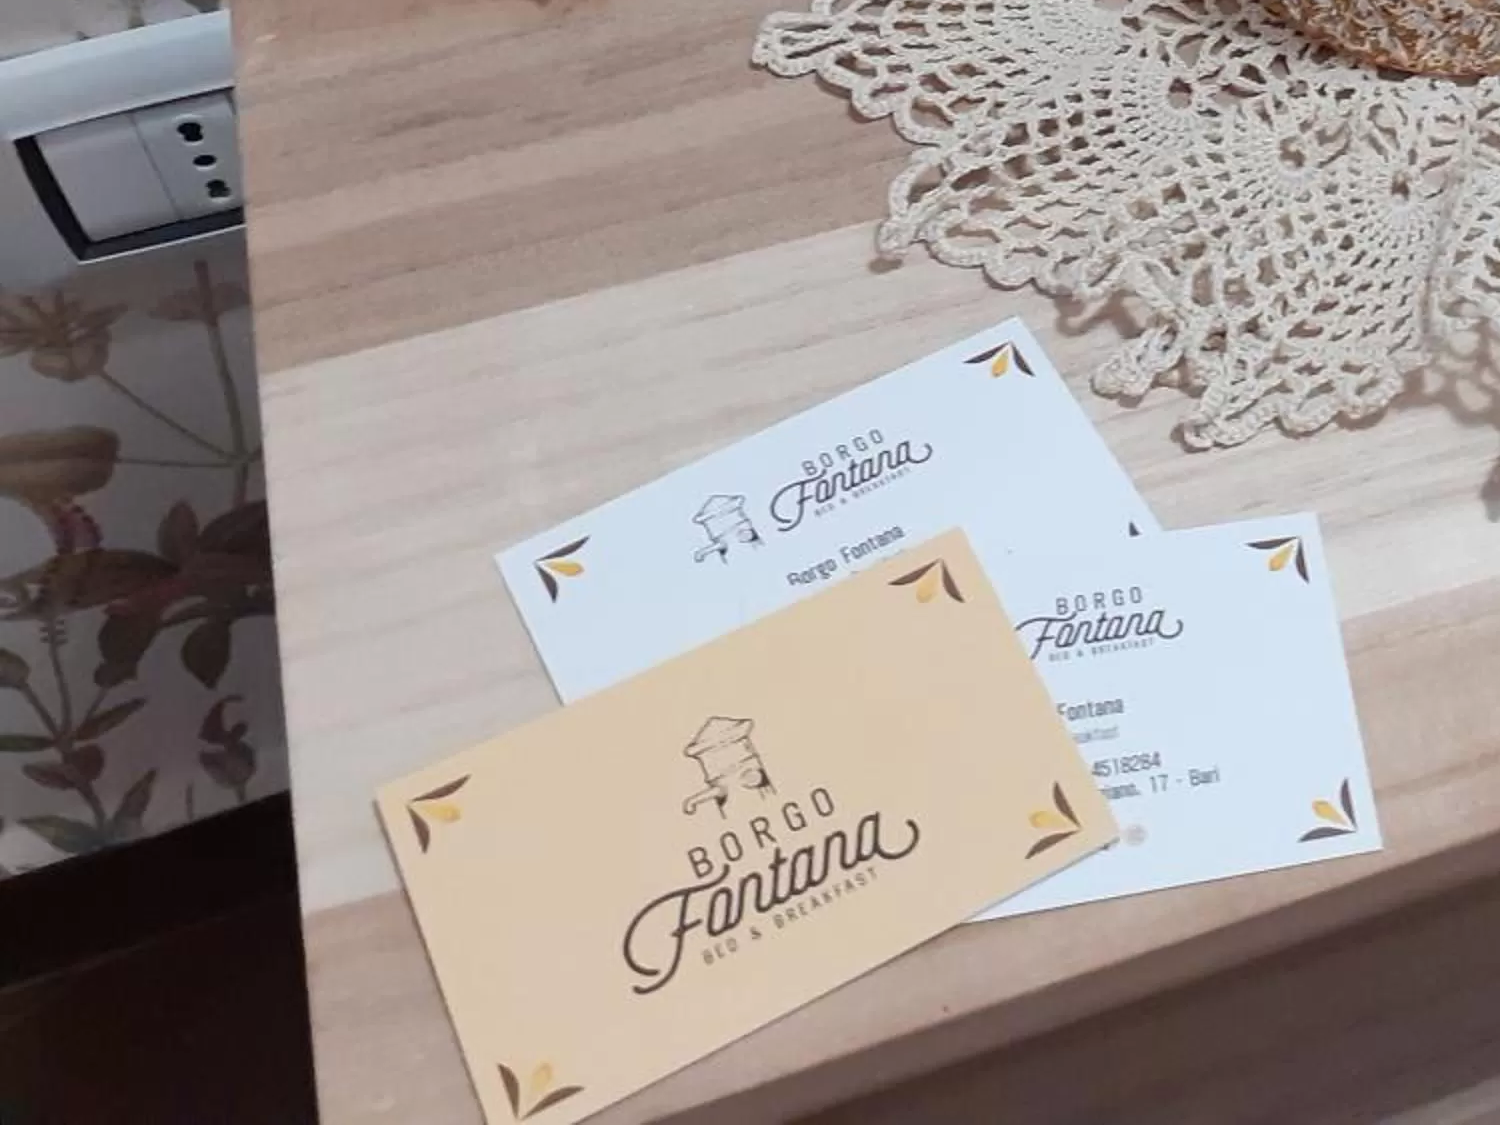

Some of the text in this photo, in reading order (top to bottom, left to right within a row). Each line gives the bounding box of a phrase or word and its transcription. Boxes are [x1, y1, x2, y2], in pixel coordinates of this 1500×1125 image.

[803, 429, 884, 476] BORGO
[770, 441, 933, 532] Fontana
[840, 526, 905, 564] Fontana
[1056, 586, 1143, 616] BORGO
[1015, 608, 1184, 660] Fontana
[1188, 767, 1220, 786] Bari
[687, 787, 835, 879] BORGO
[622, 811, 920, 994] Fontana
[701, 937, 738, 965] BED
[773, 866, 878, 929] BREAKFAST
